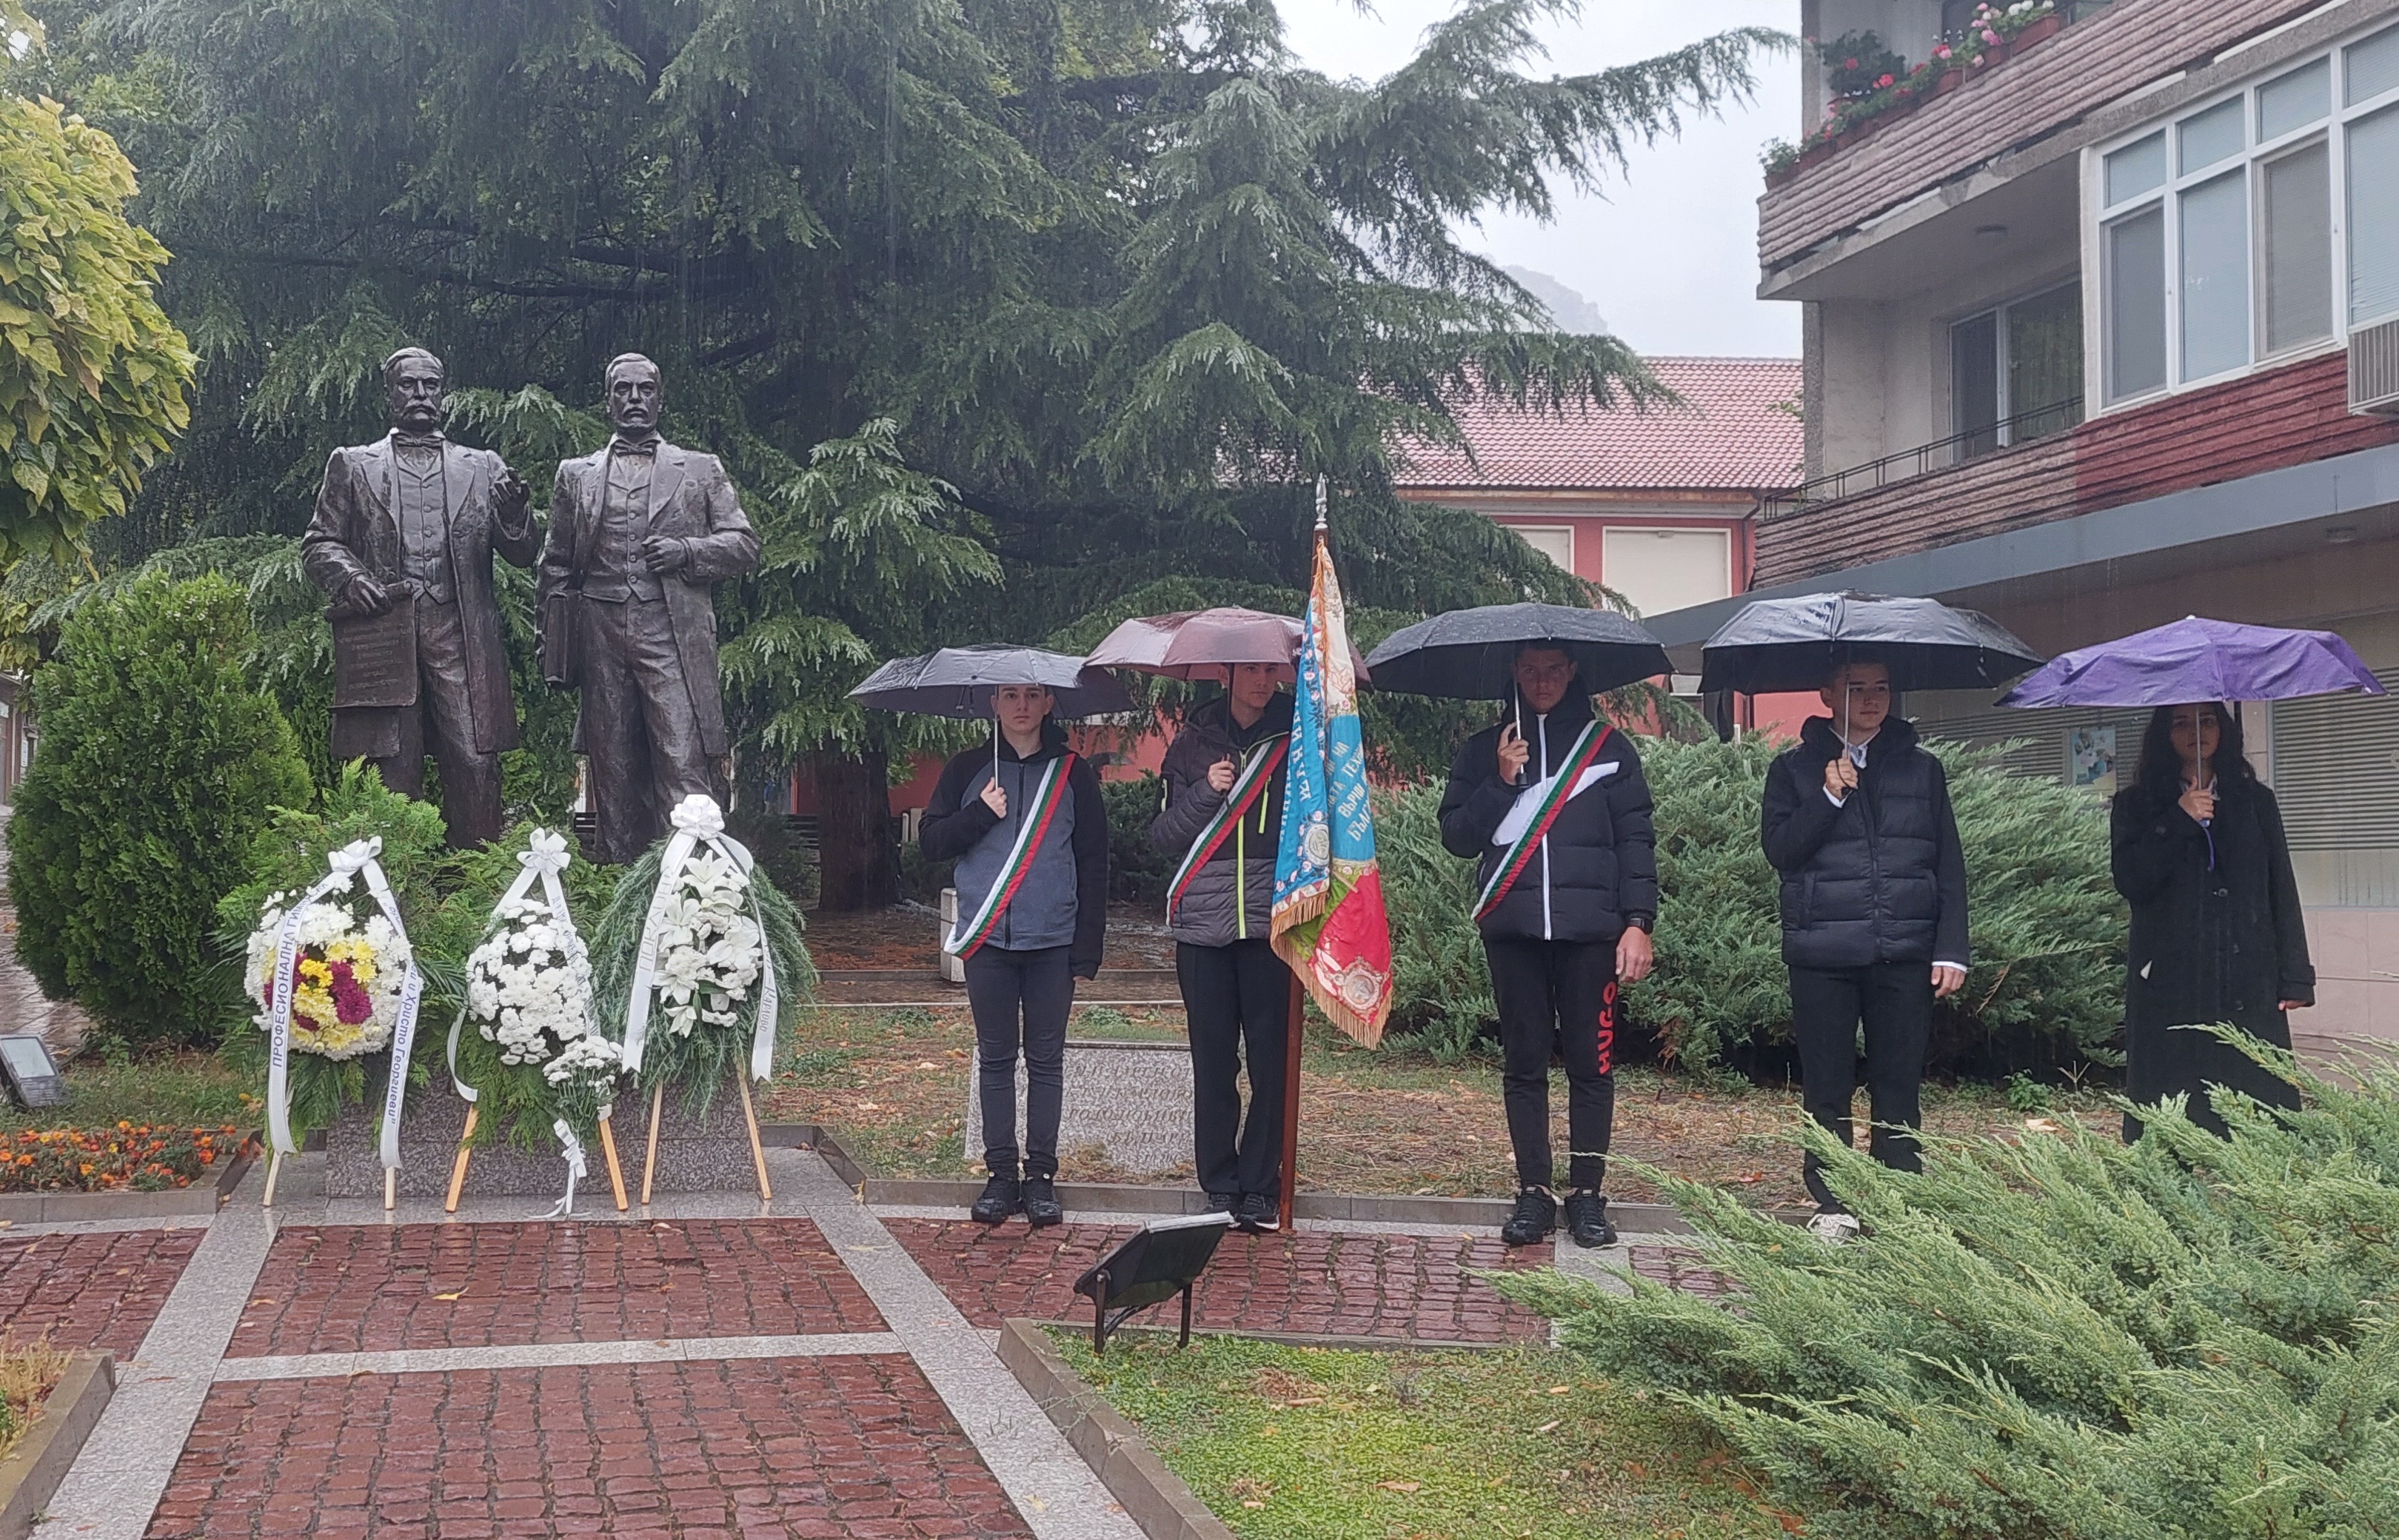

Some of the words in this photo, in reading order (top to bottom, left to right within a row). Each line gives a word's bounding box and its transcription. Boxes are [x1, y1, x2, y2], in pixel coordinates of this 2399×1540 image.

[272, 932, 295, 1068] ПРОФЕСИОНАЛНА
[398, 993, 416, 1045] Христо
[1597, 981, 1617, 1075] HUGO
